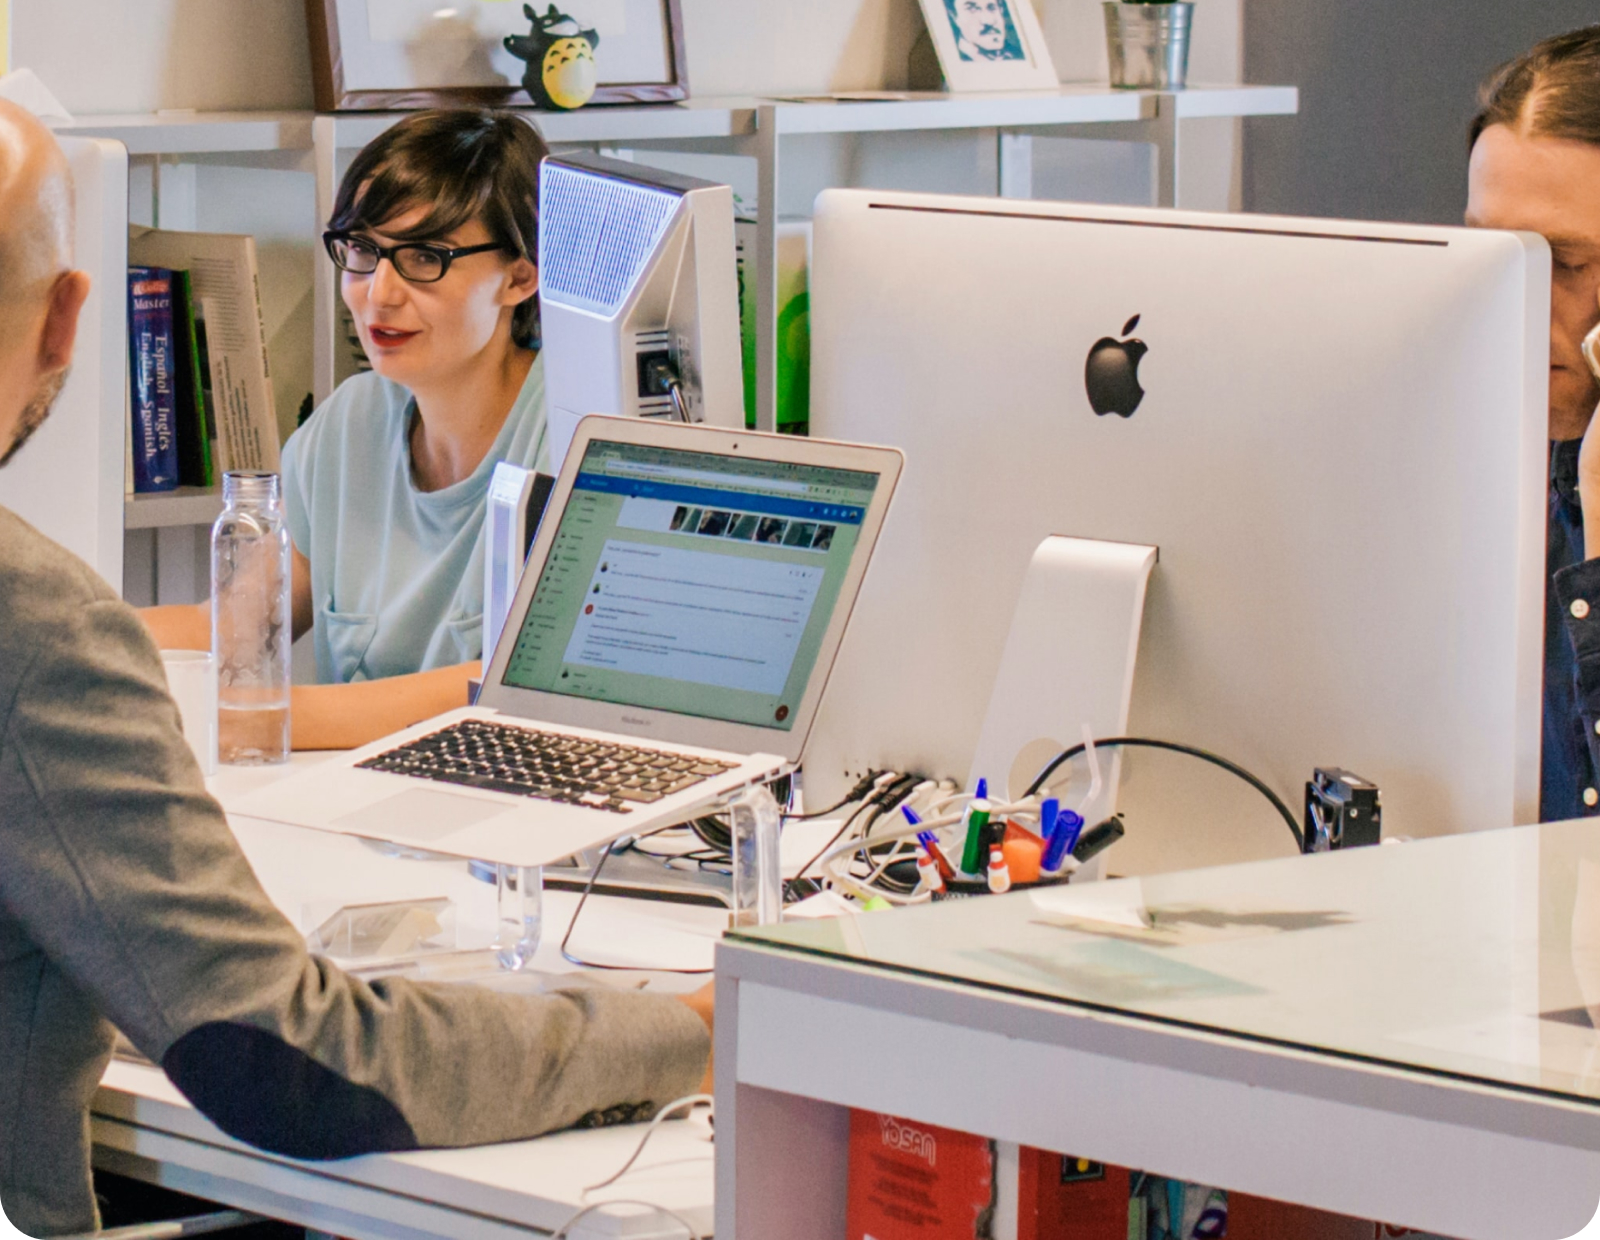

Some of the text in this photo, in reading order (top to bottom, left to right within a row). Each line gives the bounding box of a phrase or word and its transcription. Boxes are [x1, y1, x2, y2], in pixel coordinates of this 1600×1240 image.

[134, 298, 170, 310] Master
[152, 335, 170, 394] Español
[141, 400, 157, 458] Spanish
[155, 407, 171, 451] Inglés
